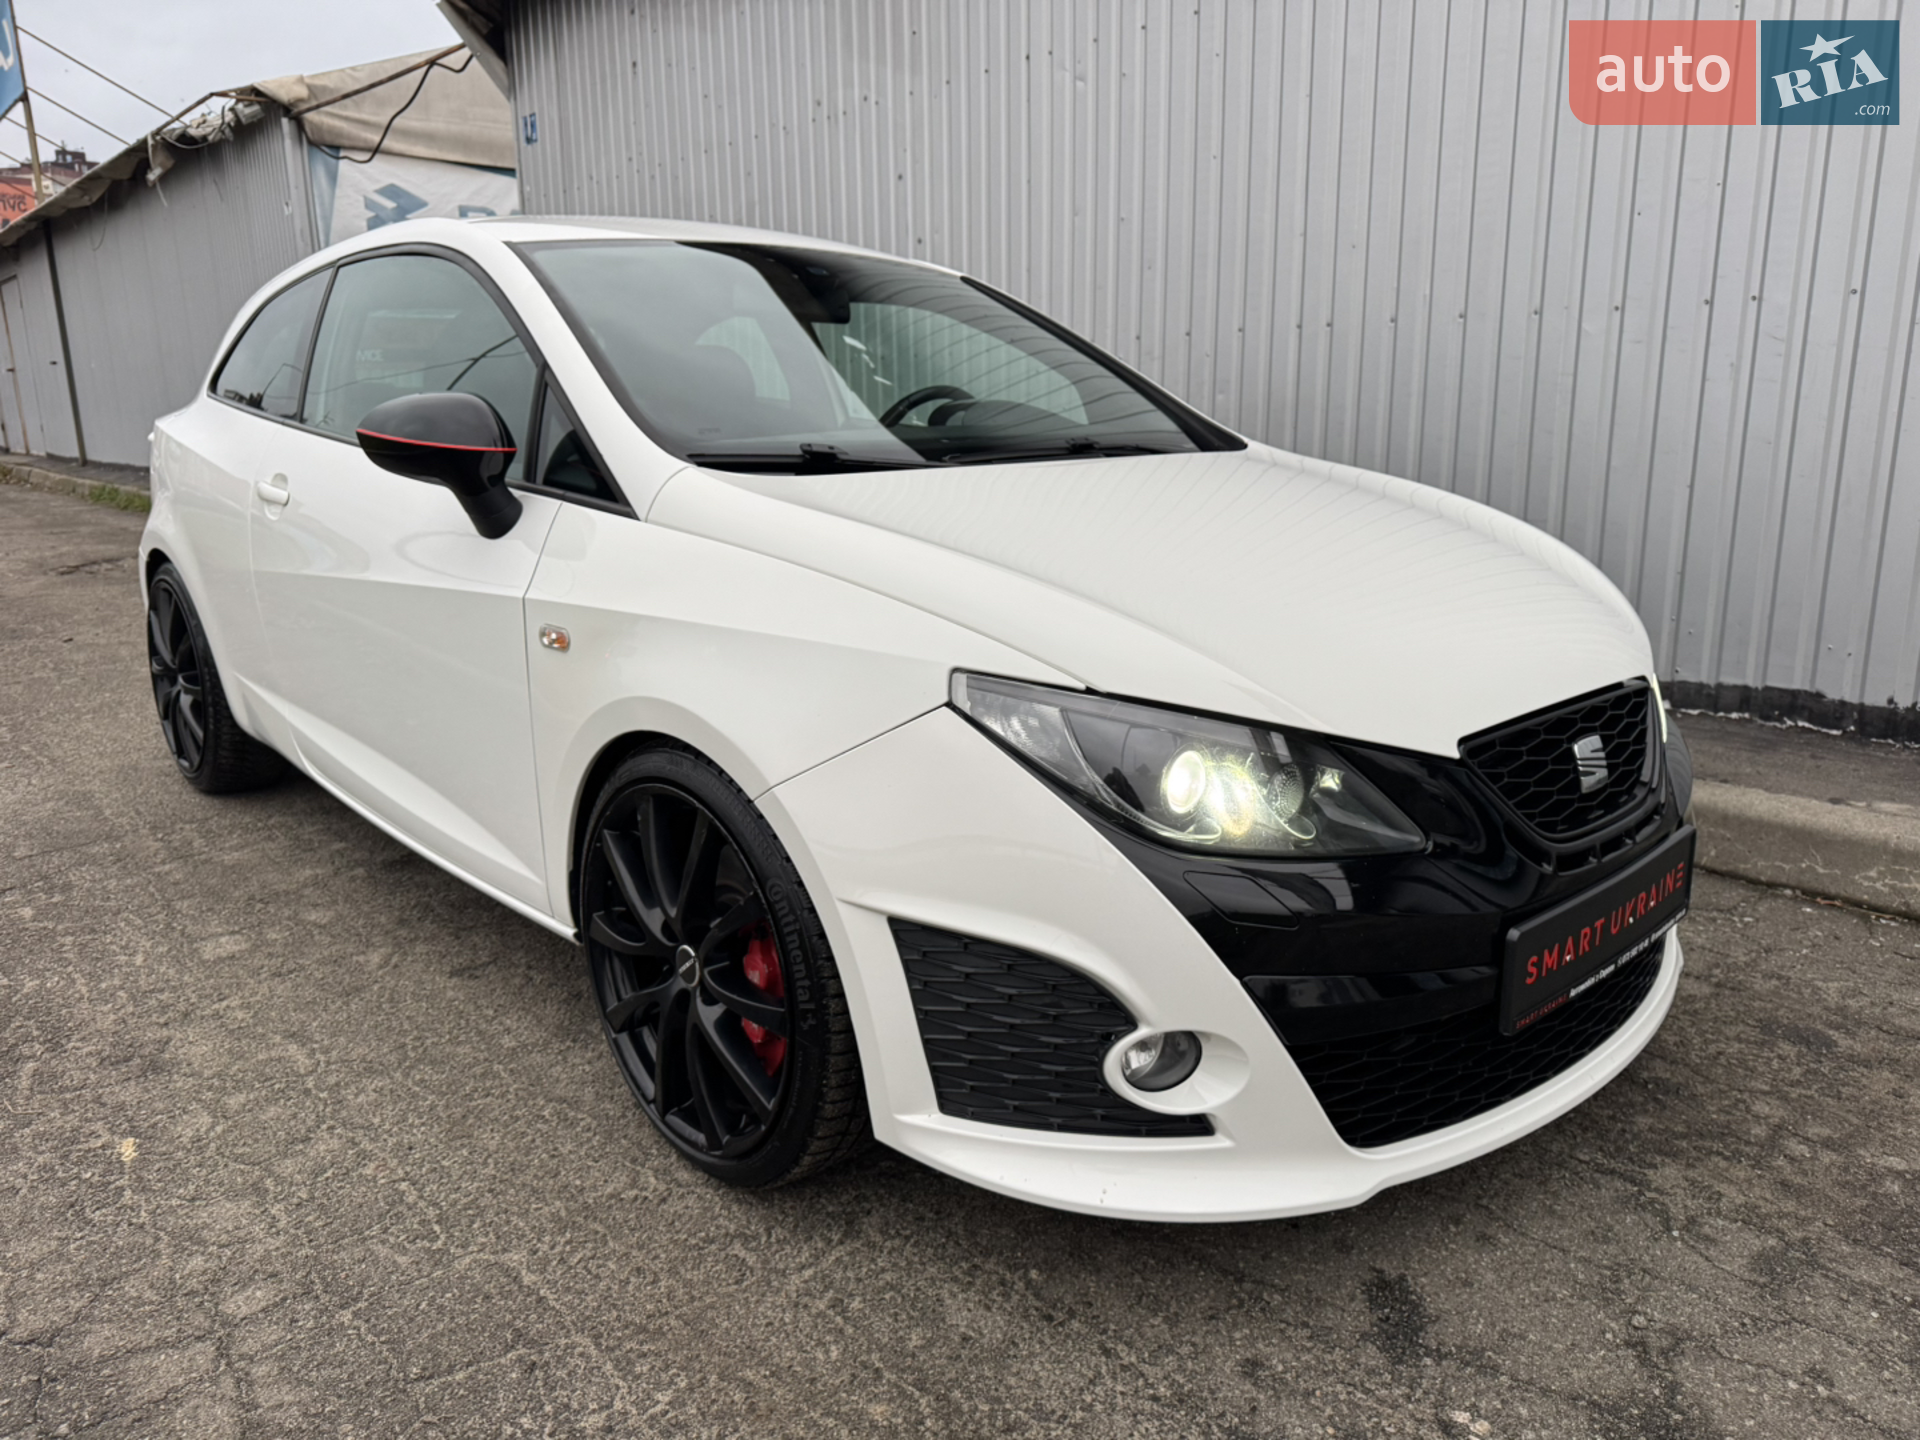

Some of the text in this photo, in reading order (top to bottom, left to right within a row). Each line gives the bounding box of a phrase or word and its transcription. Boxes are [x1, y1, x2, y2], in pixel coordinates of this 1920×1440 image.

[766, 877, 816, 1009] Continental
[1525, 917, 1606, 985] SMART
[1610, 861, 1686, 936] UKRAINE
